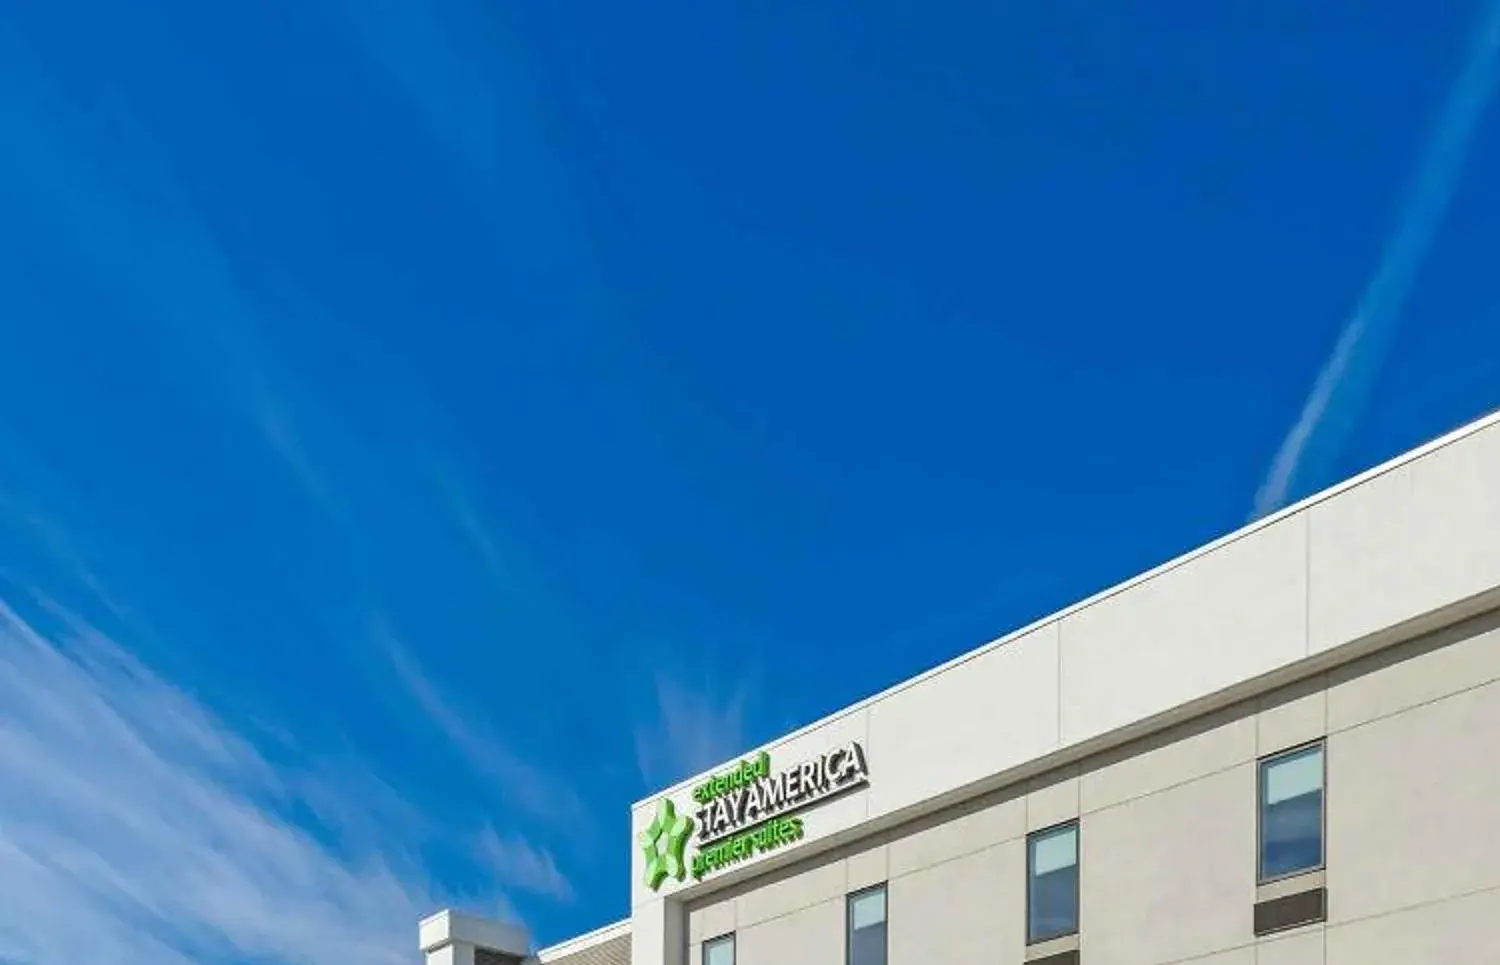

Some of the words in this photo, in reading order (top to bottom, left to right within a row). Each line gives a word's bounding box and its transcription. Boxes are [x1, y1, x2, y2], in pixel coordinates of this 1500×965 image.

[692, 751, 770, 804] extended
[692, 837, 753, 882] premier
[752, 817, 804, 853] suites
